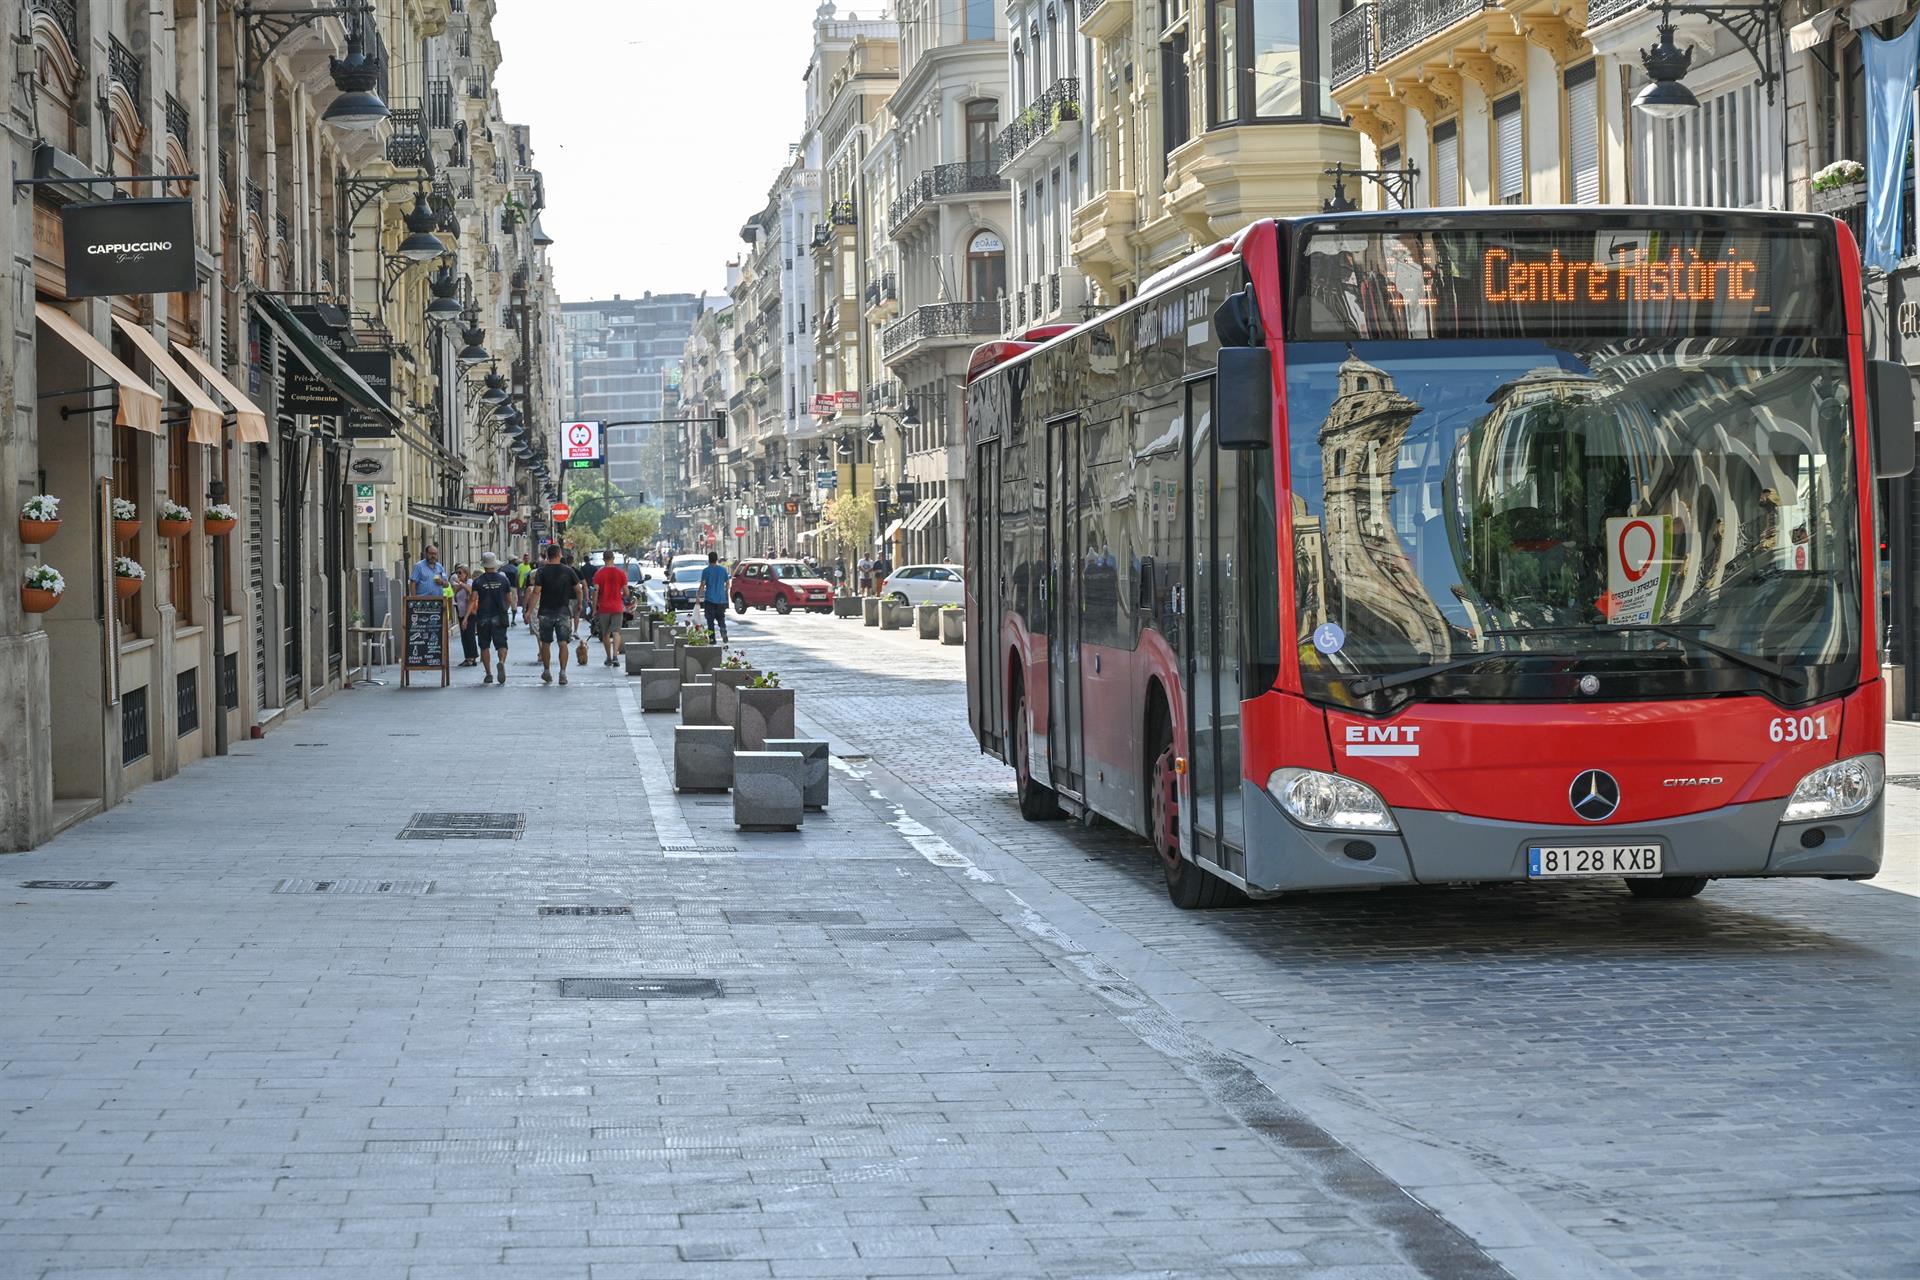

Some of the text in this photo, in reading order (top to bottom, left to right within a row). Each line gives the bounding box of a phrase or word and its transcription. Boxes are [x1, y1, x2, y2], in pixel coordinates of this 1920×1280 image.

[87, 241, 173, 255] CAPPUCCINO
[1485, 248, 1608, 301] Centre
[1618, 247, 1756, 301] Històric
[1188, 287, 1210, 320] EMT
[291, 393, 338, 402] Complementos
[1346, 726, 1420, 742] EMT
[1769, 715, 1828, 742] 6301
[1663, 776, 1724, 787] CITARO
[1545, 850, 1605, 872] 8128
[1613, 848, 1656, 870] KXB
